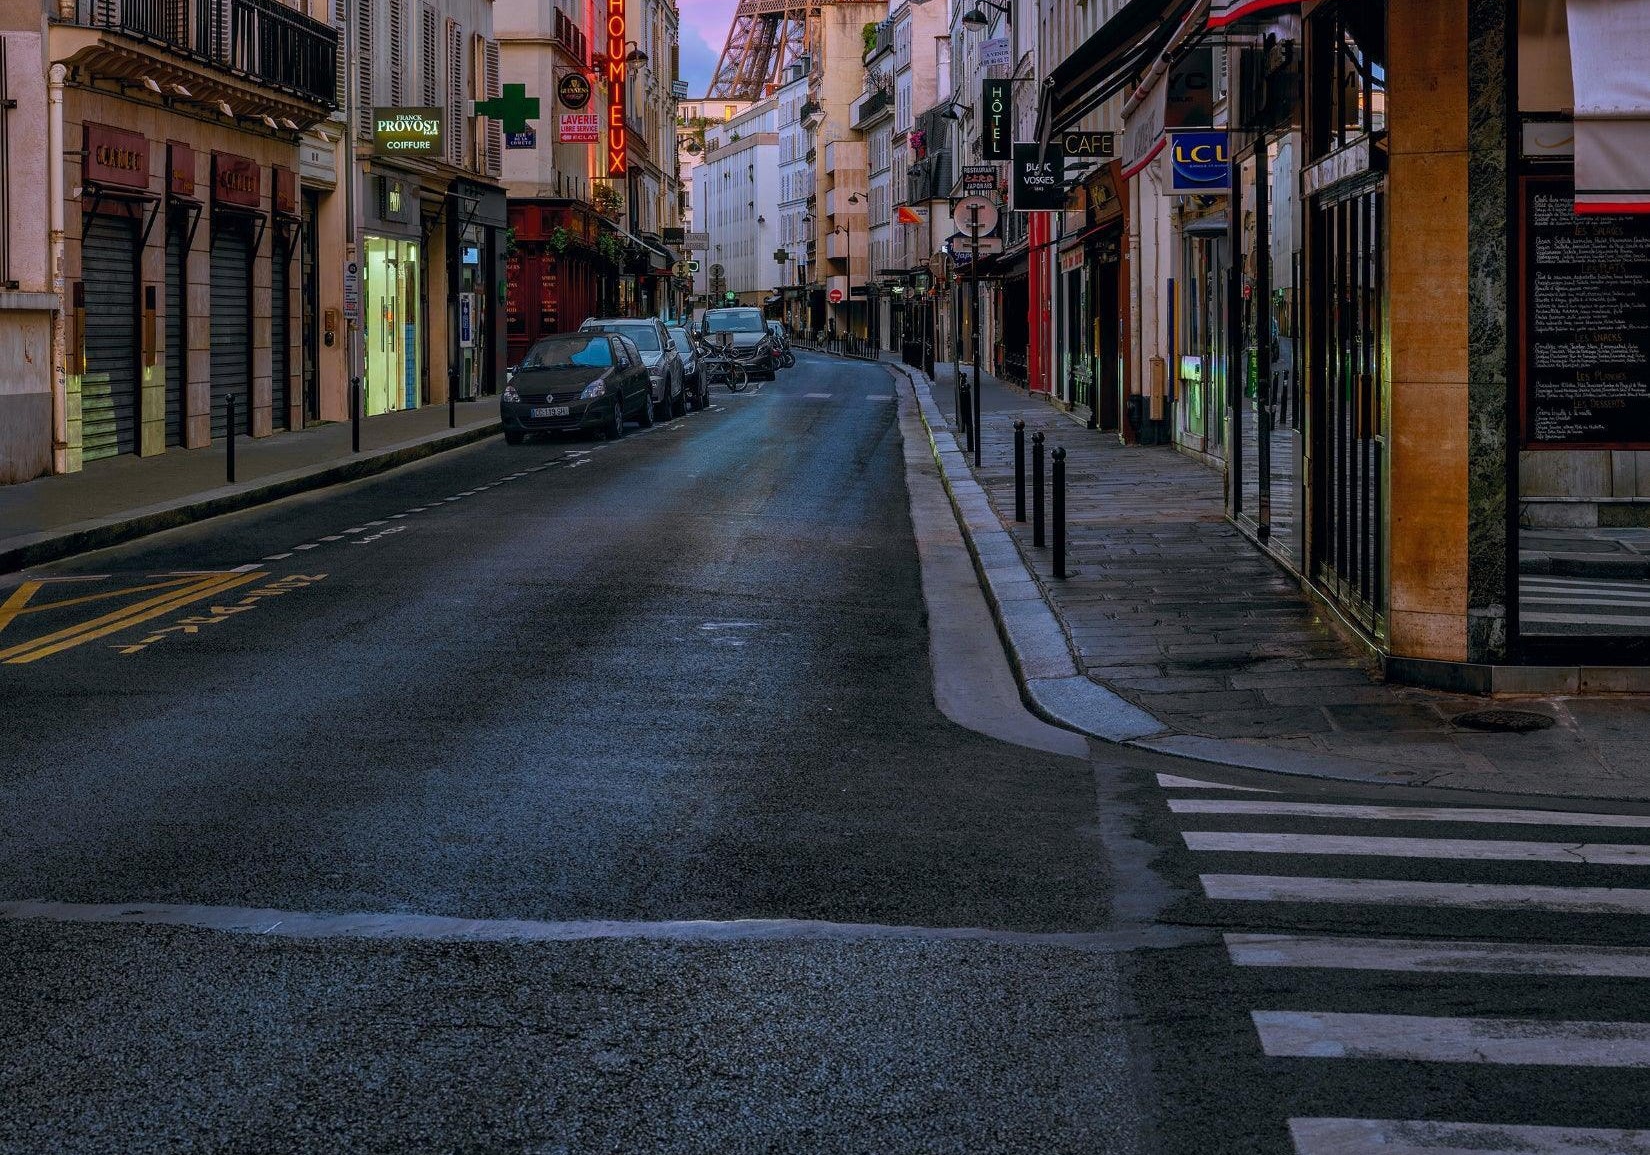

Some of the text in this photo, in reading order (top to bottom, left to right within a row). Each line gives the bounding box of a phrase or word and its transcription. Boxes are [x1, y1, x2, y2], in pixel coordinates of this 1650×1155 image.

[561, 114, 598, 125] LAVERIE
[377, 120, 440, 132] PROVOST
[386, 141, 431, 150] COIFFURE
[1176, 145, 1229, 163] LCL
[963, 166, 996, 174] RESTAURANT
[1023, 176, 1055, 185] VOSGES
